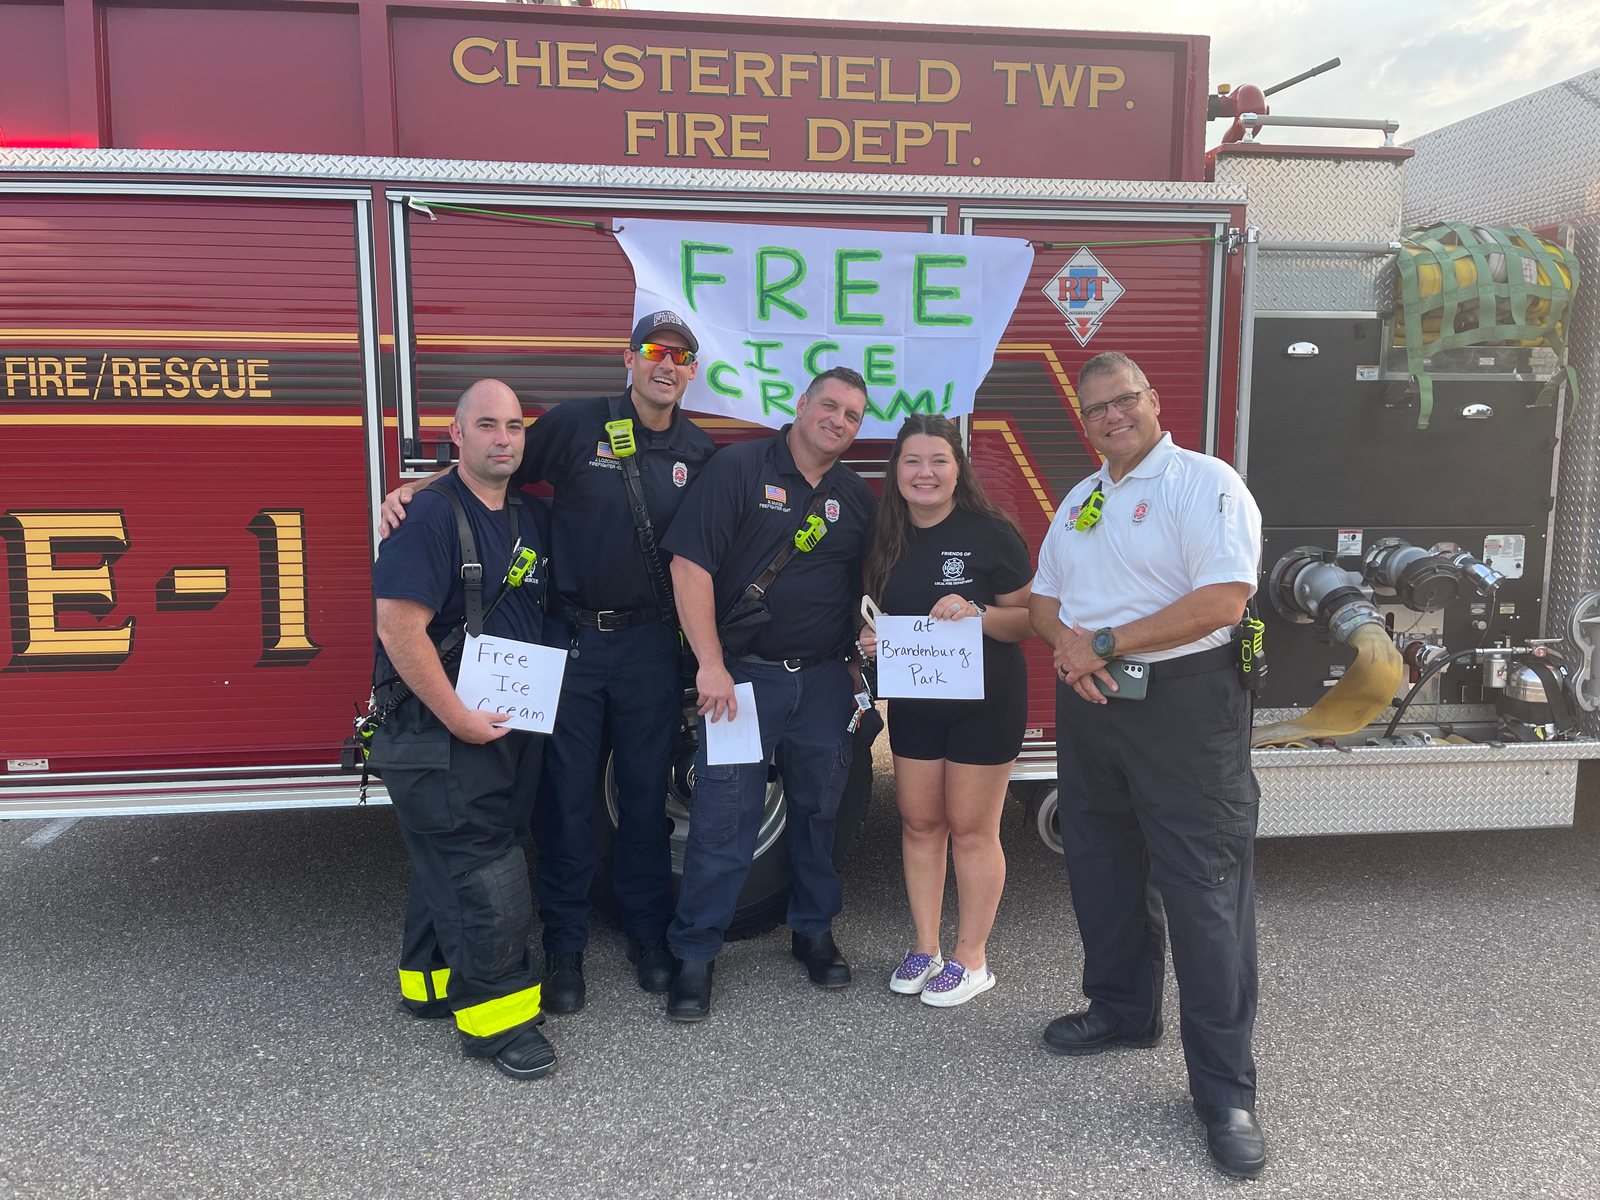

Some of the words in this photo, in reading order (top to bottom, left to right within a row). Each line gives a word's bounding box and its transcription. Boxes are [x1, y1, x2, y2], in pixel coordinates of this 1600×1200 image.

[451, 36, 962, 105] CHESTERFIELD
[993, 59, 1136, 111] TWP.
[624, 109, 771, 161] FIRE
[805, 116, 983, 167] DEPT.
[680, 239, 974, 327] FREE
[1057, 276, 1110, 302] RIT
[4, 353, 272, 400] FIRE/RESCUE
[743, 339, 896, 386] ICE
[913, 619, 935, 632] at
[477, 642, 529, 669] Free
[881, 639, 972, 668] Brandenburg
[491, 673, 530, 696] Ice
[907, 663, 948, 686] Park
